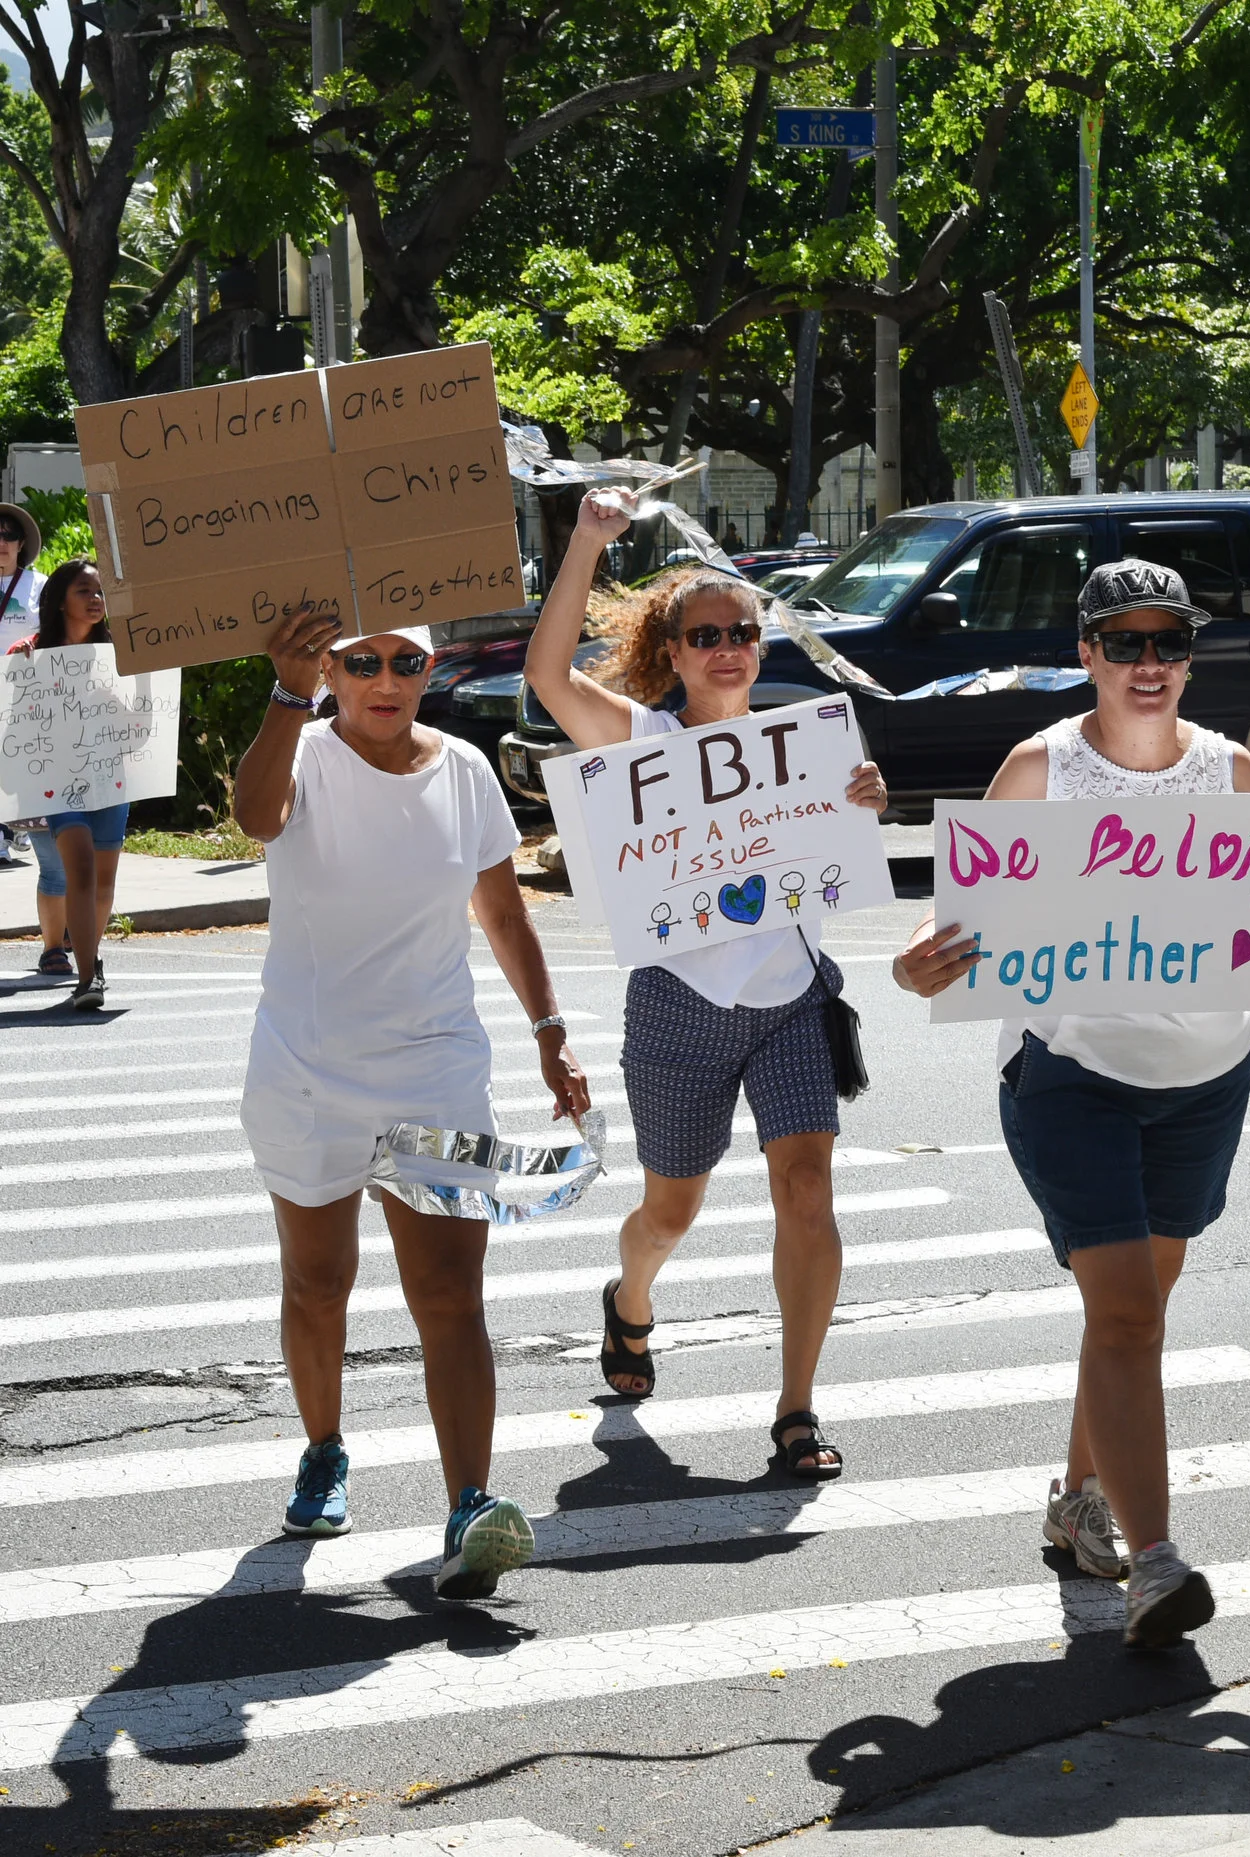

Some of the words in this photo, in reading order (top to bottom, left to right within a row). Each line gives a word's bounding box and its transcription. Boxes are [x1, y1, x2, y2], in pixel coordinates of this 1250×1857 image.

[790, 124, 800, 142] S
[808, 125, 845, 143] KING
[1072, 381, 1086, 395] LEFT
[1070, 398, 1088, 411] LANE
[120, 388, 306, 459] Children
[1072, 415, 1088, 428] ENDS
[136, 492, 320, 546] Bargaining
[364, 445, 499, 503] Chips!
[1113, 566, 1175, 597] W
[126, 607, 238, 653] Families
[50, 652, 108, 677] Means
[9, 677, 75, 704] Family
[63, 700, 117, 721] Means
[125, 693, 180, 719] Nobody
[3, 733, 54, 758] Gets
[28, 759, 54, 774] or
[69, 745, 152, 778] Forgotten
[618, 826, 687, 872] NOT
[706, 820, 723, 844] A
[739, 800, 838, 832] Partisan
[948, 816, 1039, 887] We
